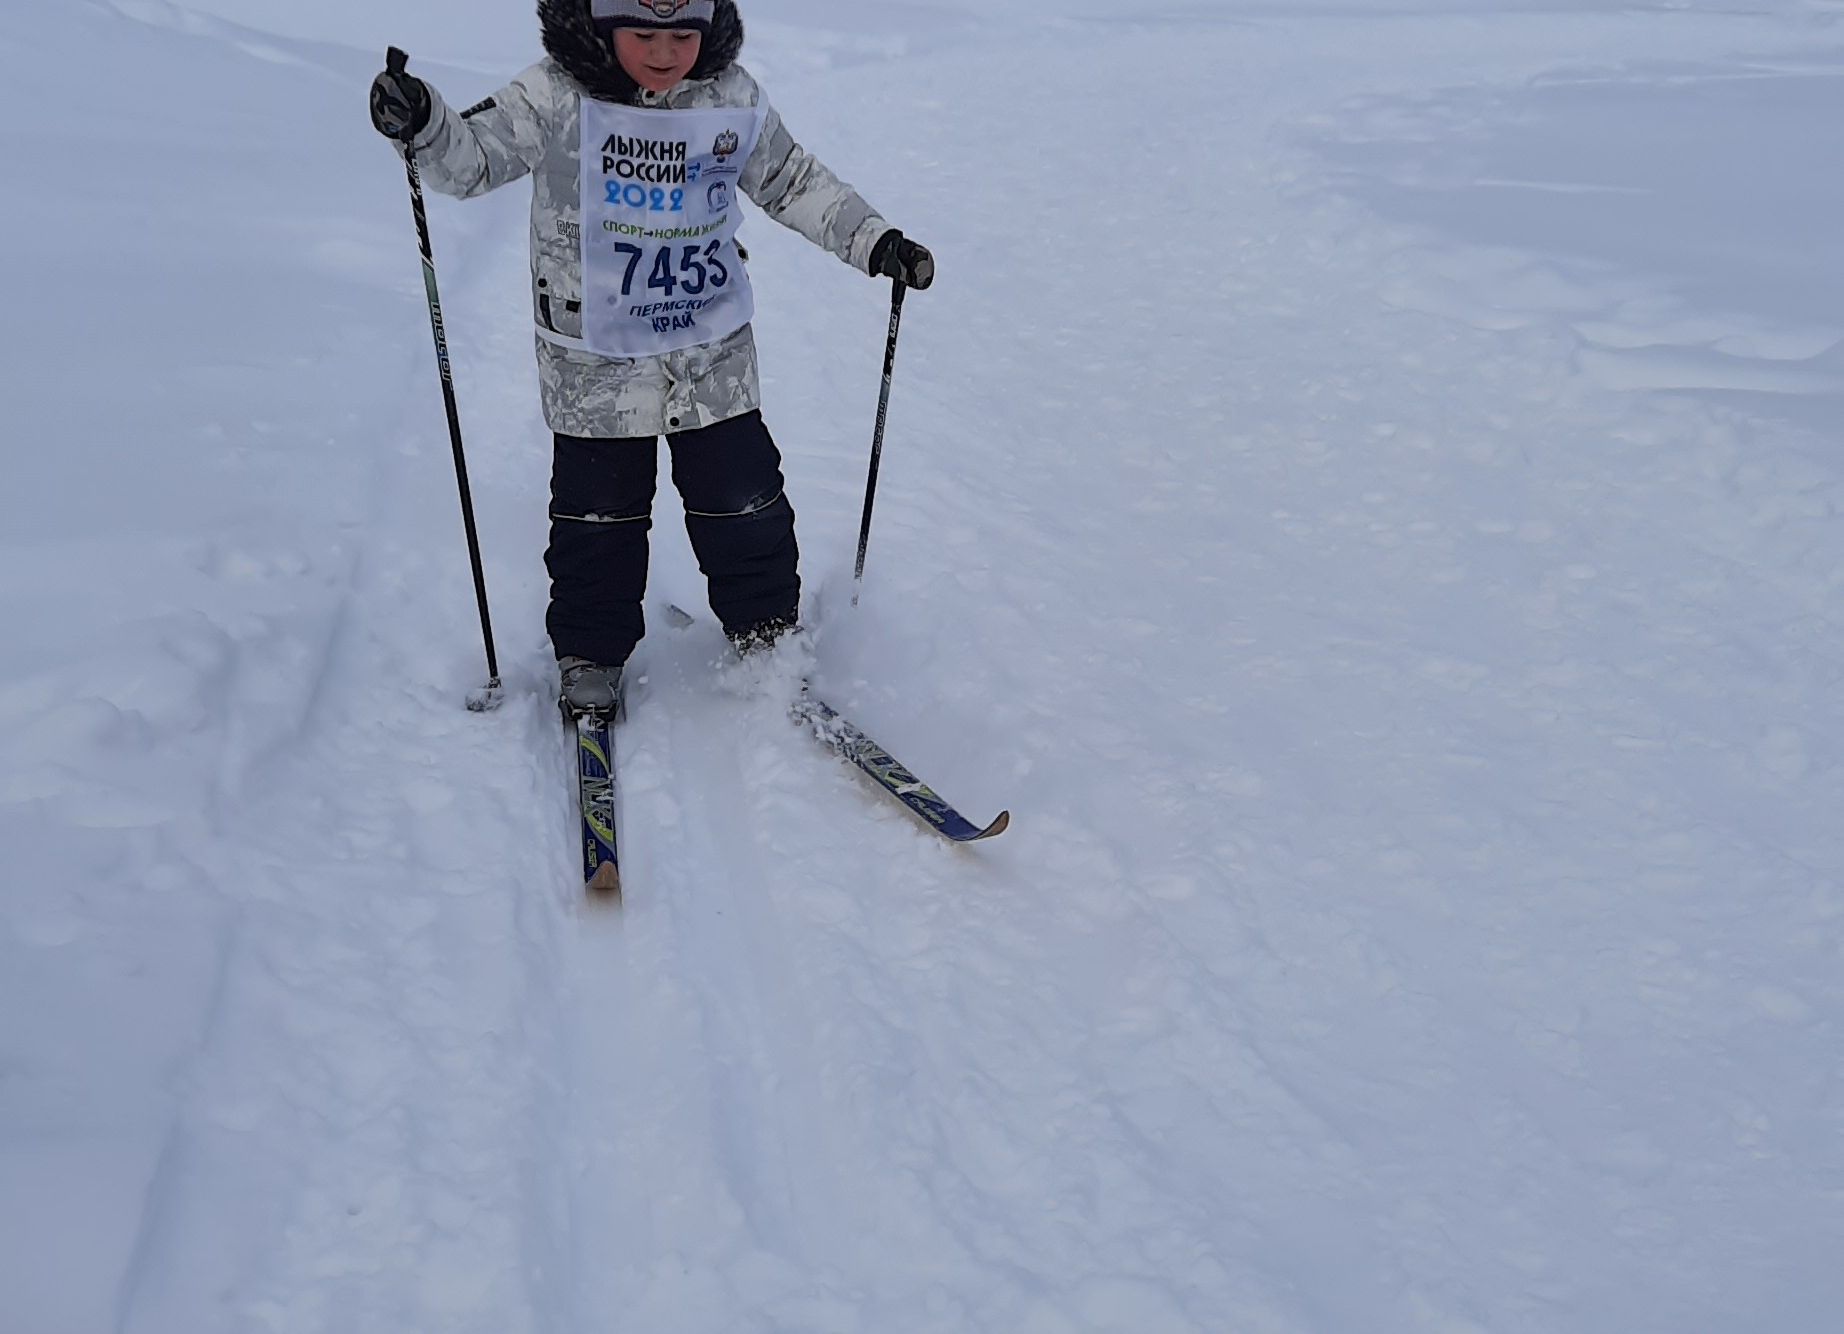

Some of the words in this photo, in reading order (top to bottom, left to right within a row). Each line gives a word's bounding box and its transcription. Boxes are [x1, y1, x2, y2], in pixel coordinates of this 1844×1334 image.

[601, 133, 687, 162] ЛЫЖНЯ
[602, 155, 687, 184] РОССИИ
[603, 180, 684, 212] 2022
[602, 219, 645, 239] СПОРТ
[655, 225, 700, 240] НОРМА
[613, 238, 728, 297] 7453
[653, 311, 697, 333] КРАЙ
